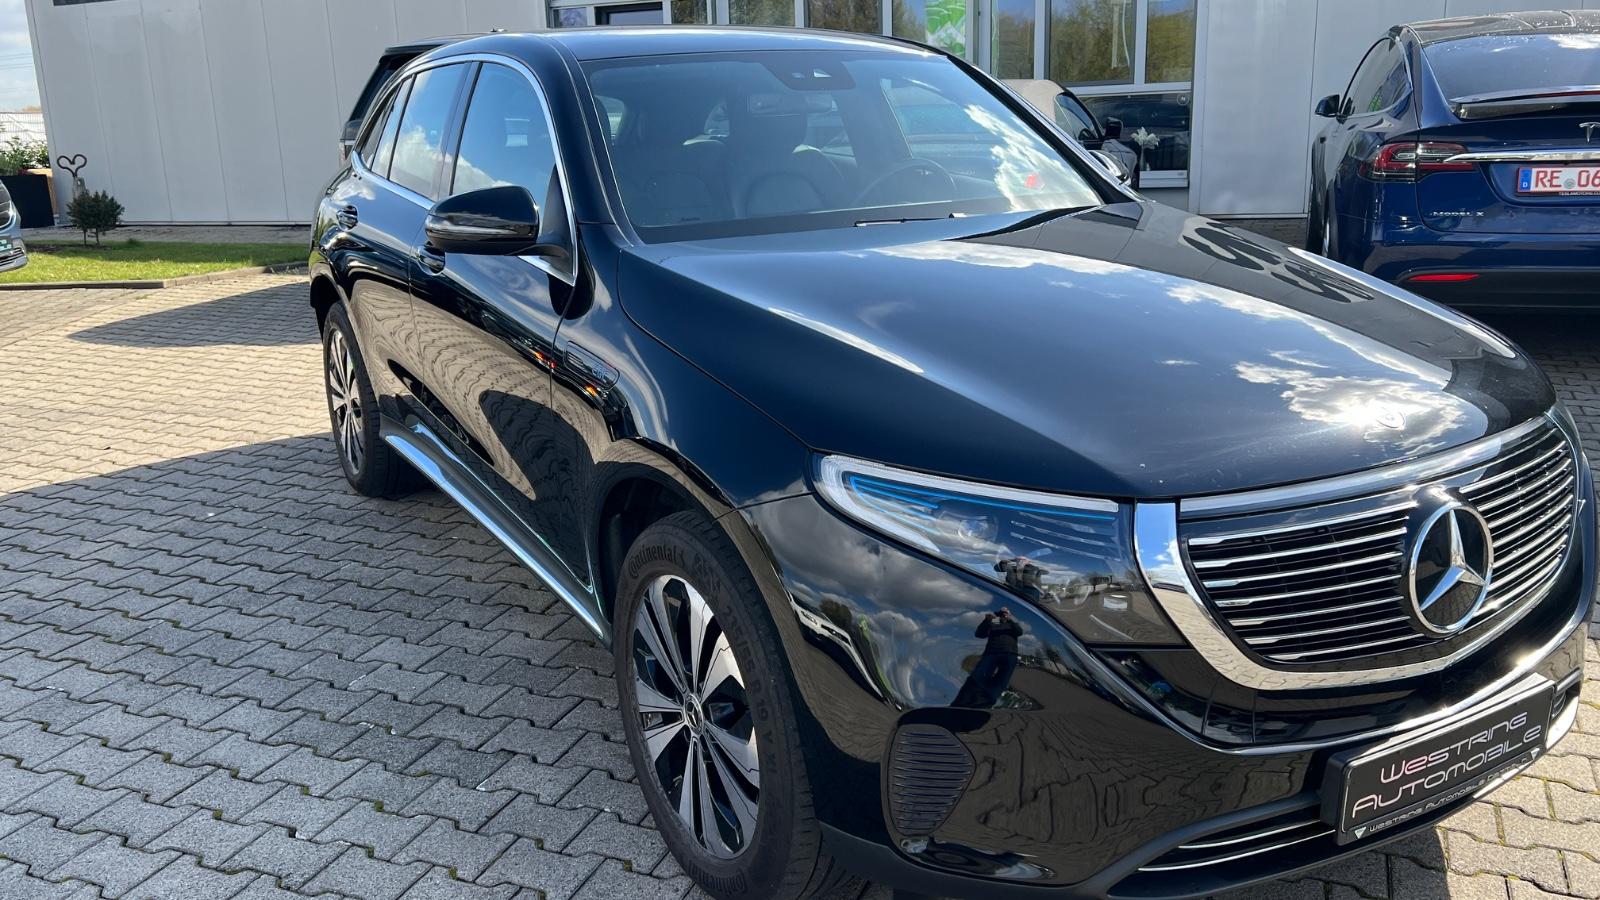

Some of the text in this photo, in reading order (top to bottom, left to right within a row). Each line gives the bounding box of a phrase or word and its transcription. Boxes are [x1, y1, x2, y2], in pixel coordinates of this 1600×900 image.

[1535, 170, 1562, 188] RE
[628, 544, 677, 579] Continental
[1352, 725, 1542, 819] AUTOMOBILE
[1380, 711, 1528, 784] WESTRING
